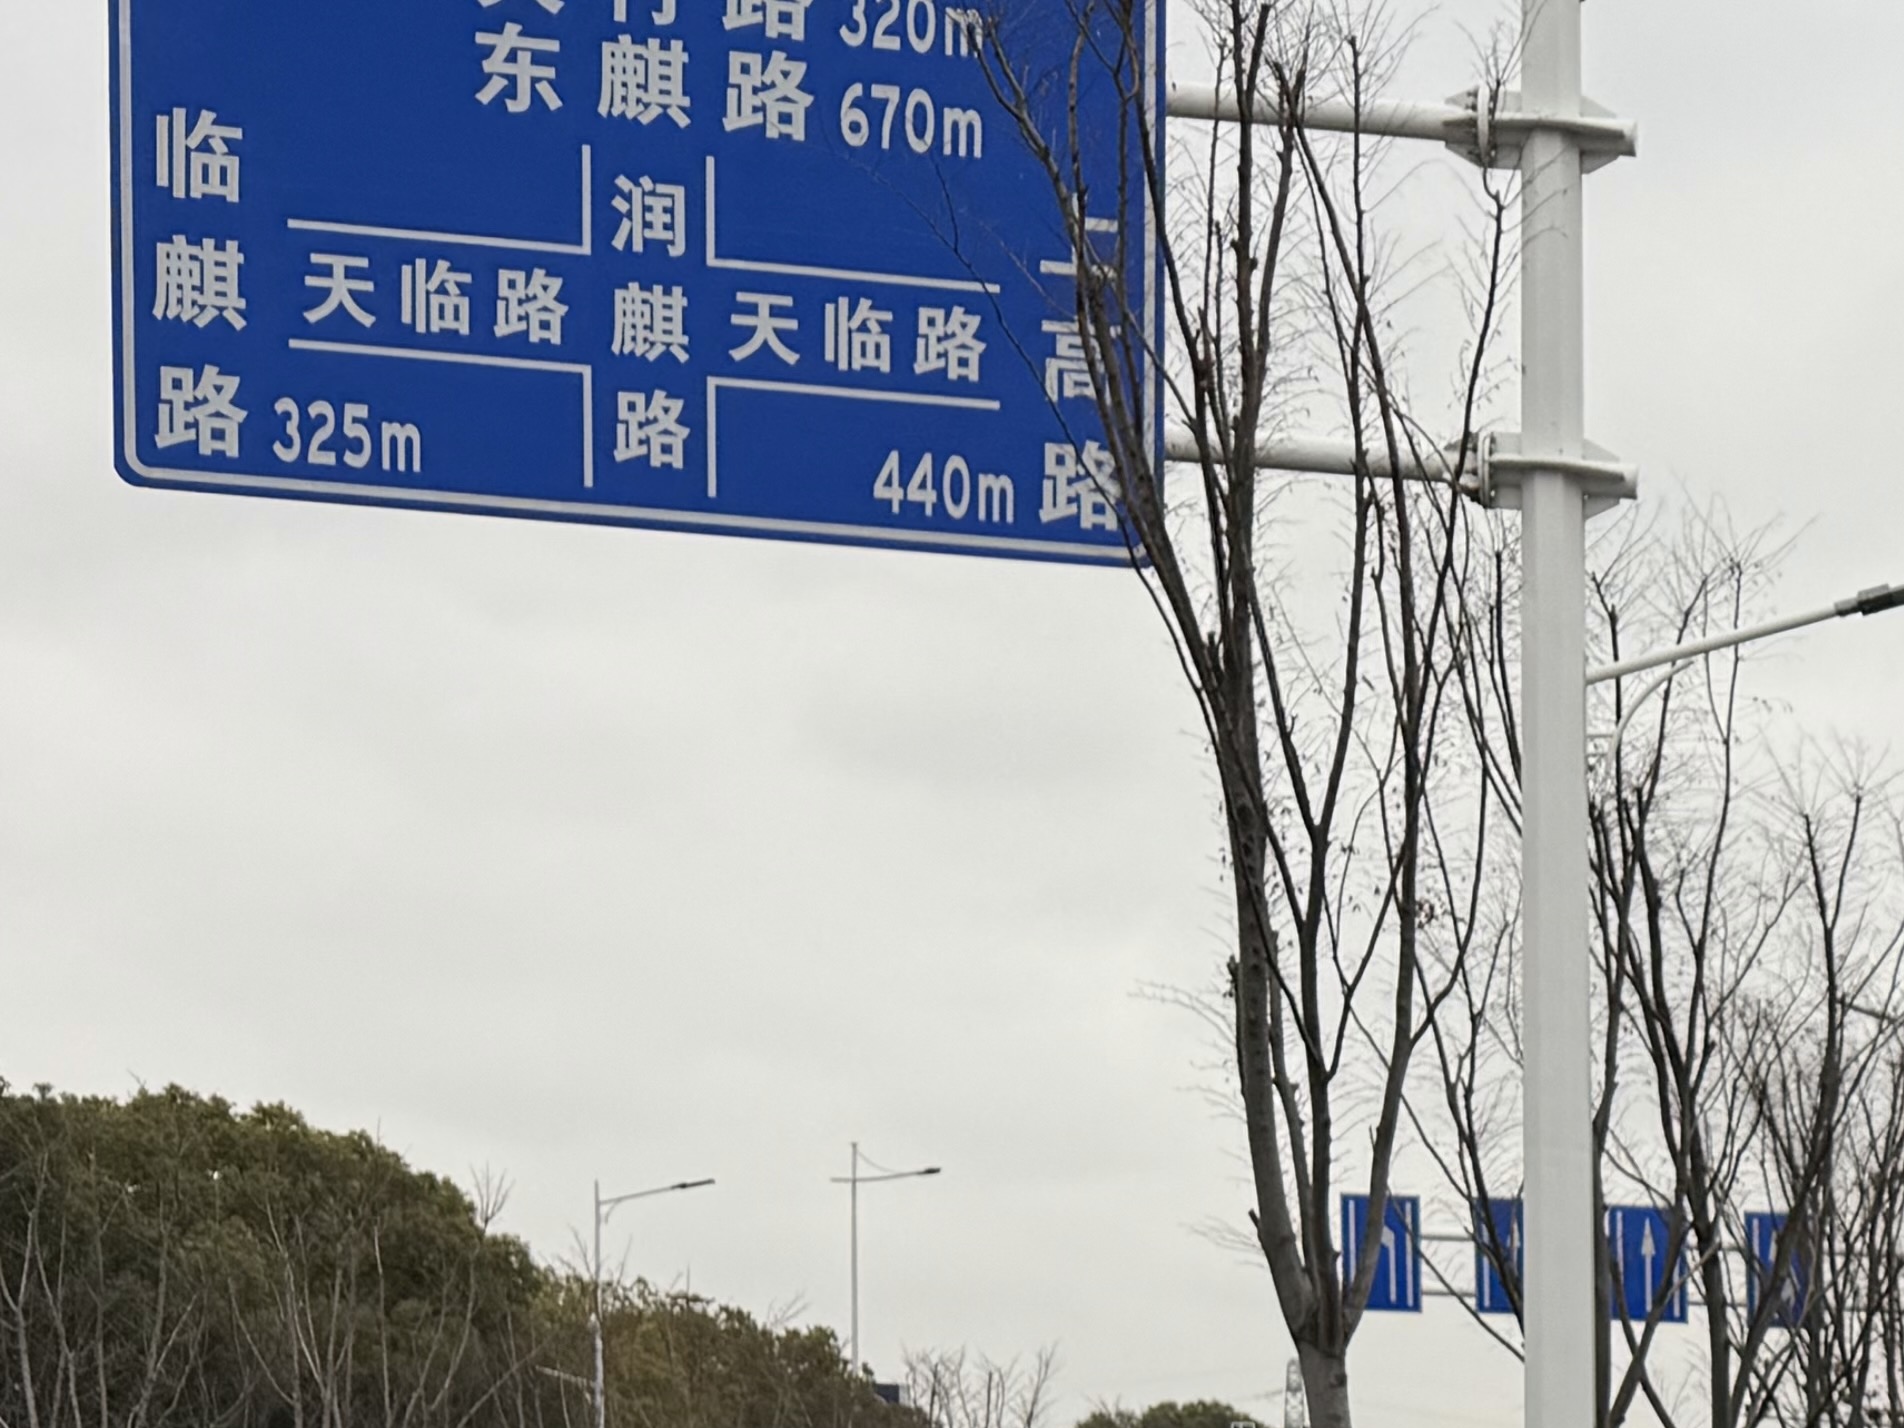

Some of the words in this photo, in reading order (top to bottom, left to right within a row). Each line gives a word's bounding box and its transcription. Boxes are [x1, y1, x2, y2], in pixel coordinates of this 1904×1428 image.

[475, 21, 813, 141] 东麒路
[839, 83, 982, 159] 670m
[152, 107, 248, 459] 临麒路
[303, 253, 569, 345] 天临路
[611, 174, 690, 469] 润麒路
[728, 291, 987, 382] 天临路
[272, 397, 421, 472] 325m
[873, 450, 1014, 523] 440m
